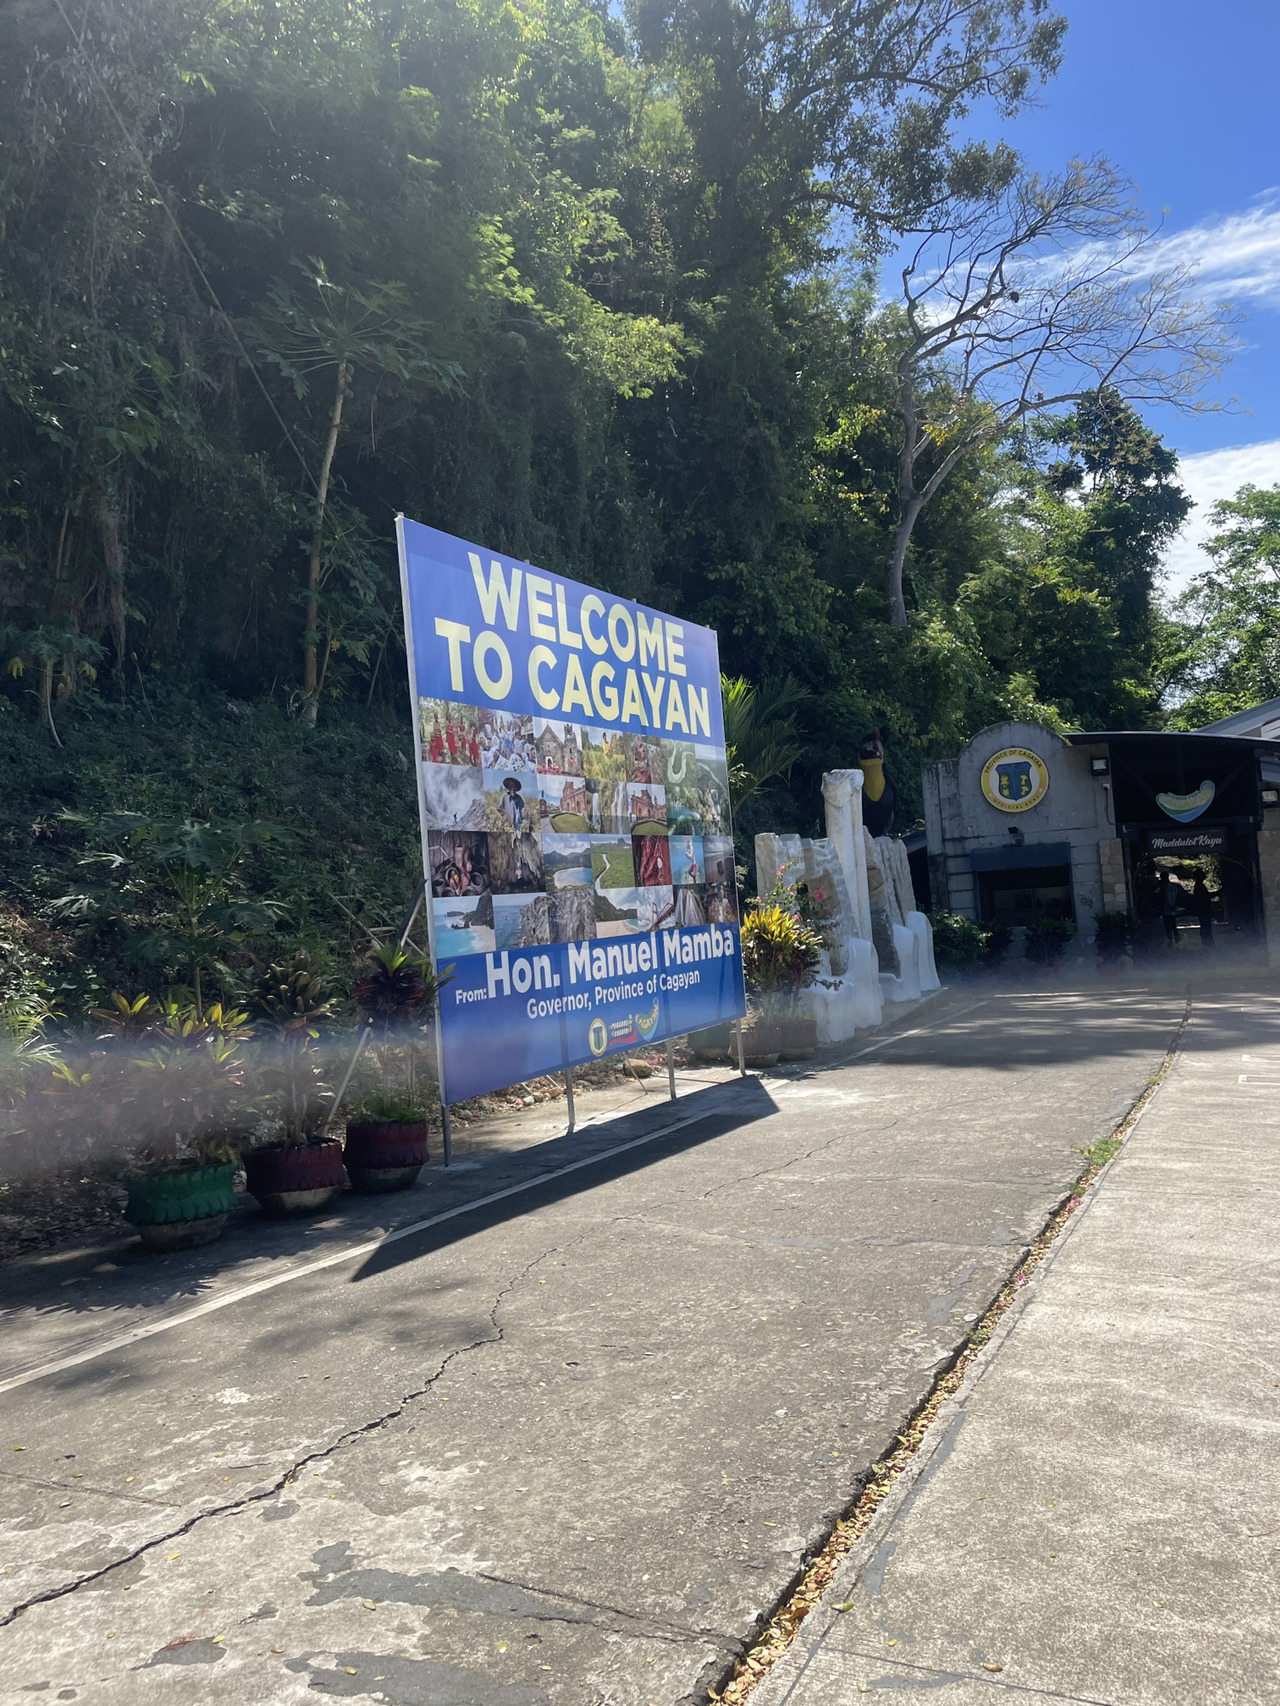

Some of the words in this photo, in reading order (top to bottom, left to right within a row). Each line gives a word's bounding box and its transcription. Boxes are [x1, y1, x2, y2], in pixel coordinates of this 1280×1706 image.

[467, 551, 687, 677] WELCOME
[434, 617, 513, 701] TO
[527, 645, 711, 738] CAGAYAN
[984, 751, 1008, 774] PROVINCE
[1018, 750, 1043, 769] CAGAYAN
[993, 798, 1023, 810] OFFICIAL
[1025, 795, 1040, 807] SEAL
[455, 988, 487, 1005] From:
[485, 950, 561, 999] Hon.
[567, 931, 659, 985] Manuel
[662, 923, 735, 967] Mamba
[526, 992, 592, 1020] Governor,
[594, 981, 644, 1006] Province
[646, 974, 657, 995] of
[659, 969, 701, 992] Cagayan
